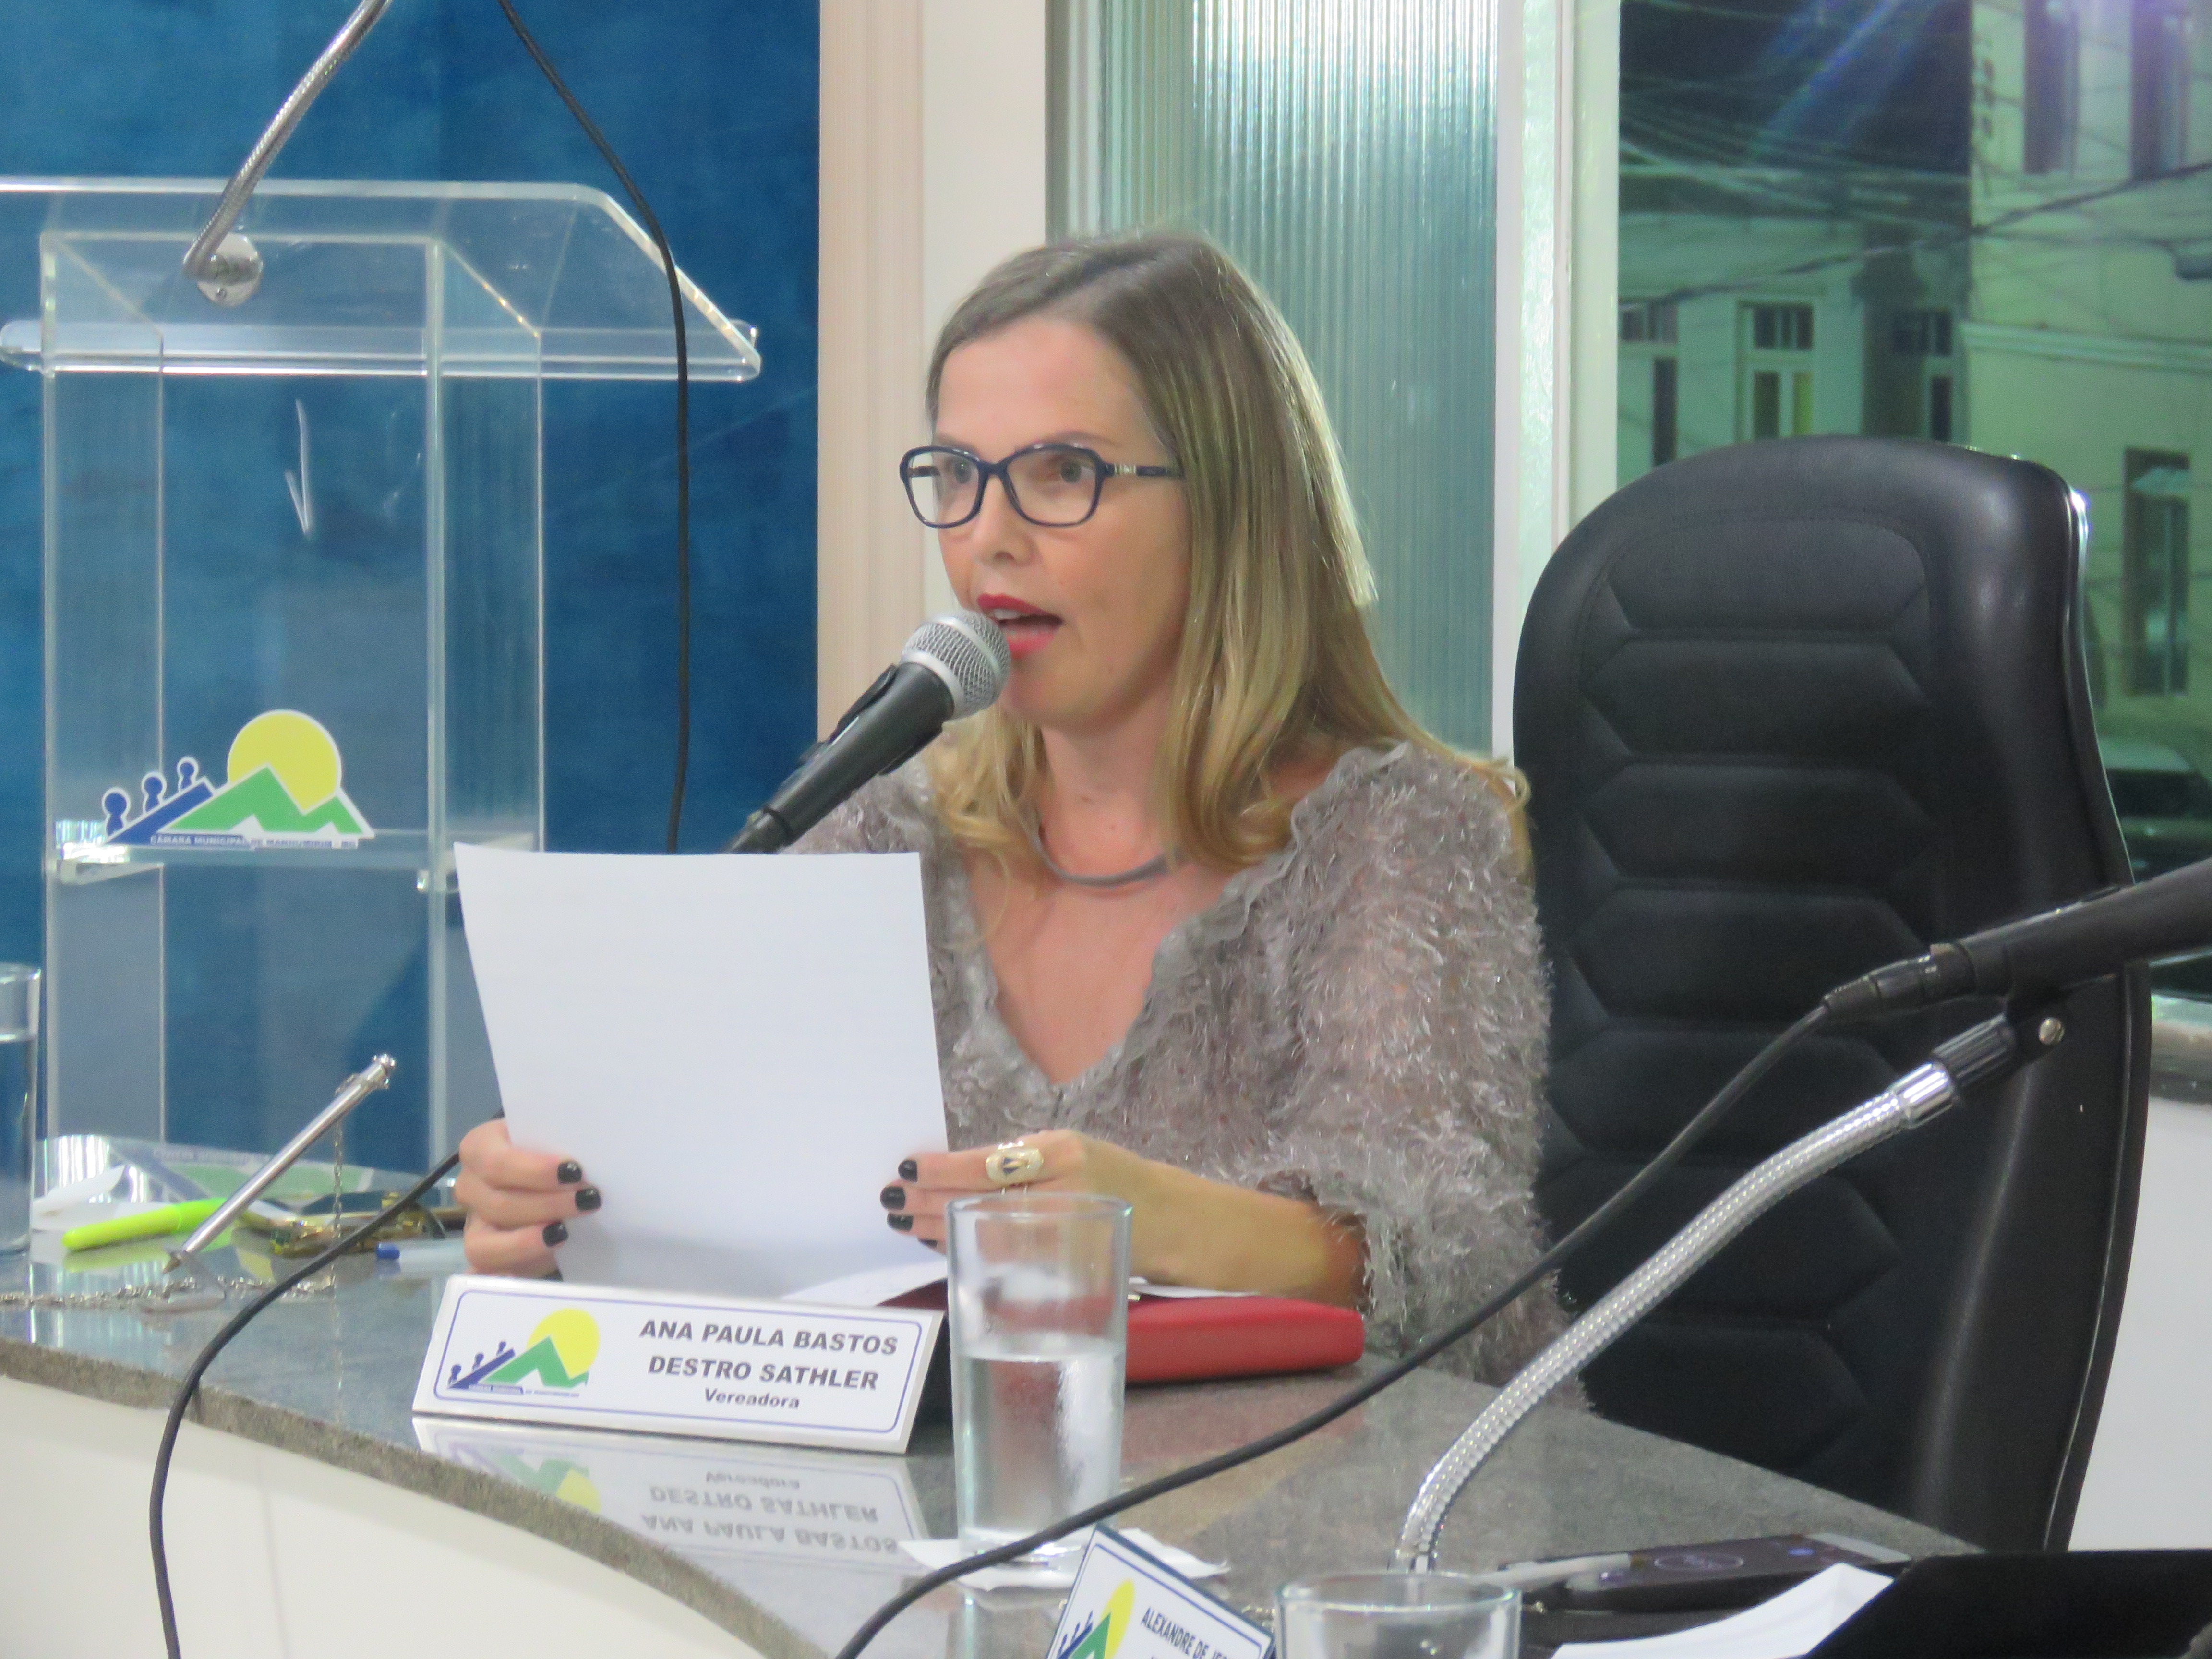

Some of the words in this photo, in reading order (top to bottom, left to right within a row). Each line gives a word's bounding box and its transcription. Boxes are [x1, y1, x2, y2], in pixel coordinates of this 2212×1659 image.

[639, 1319, 693, 1341] ANA
[701, 1323, 784, 1348] PAULA
[793, 1330, 898, 1355] BASTOS
[648, 1355, 752, 1381] DESTRO
[759, 1363, 879, 1390] SATHLER
[704, 1388, 800, 1409] Vereadora
[1141, 1607, 1196, 1656] ALEXANDRE
[1192, 1639, 1209, 1659] DE
